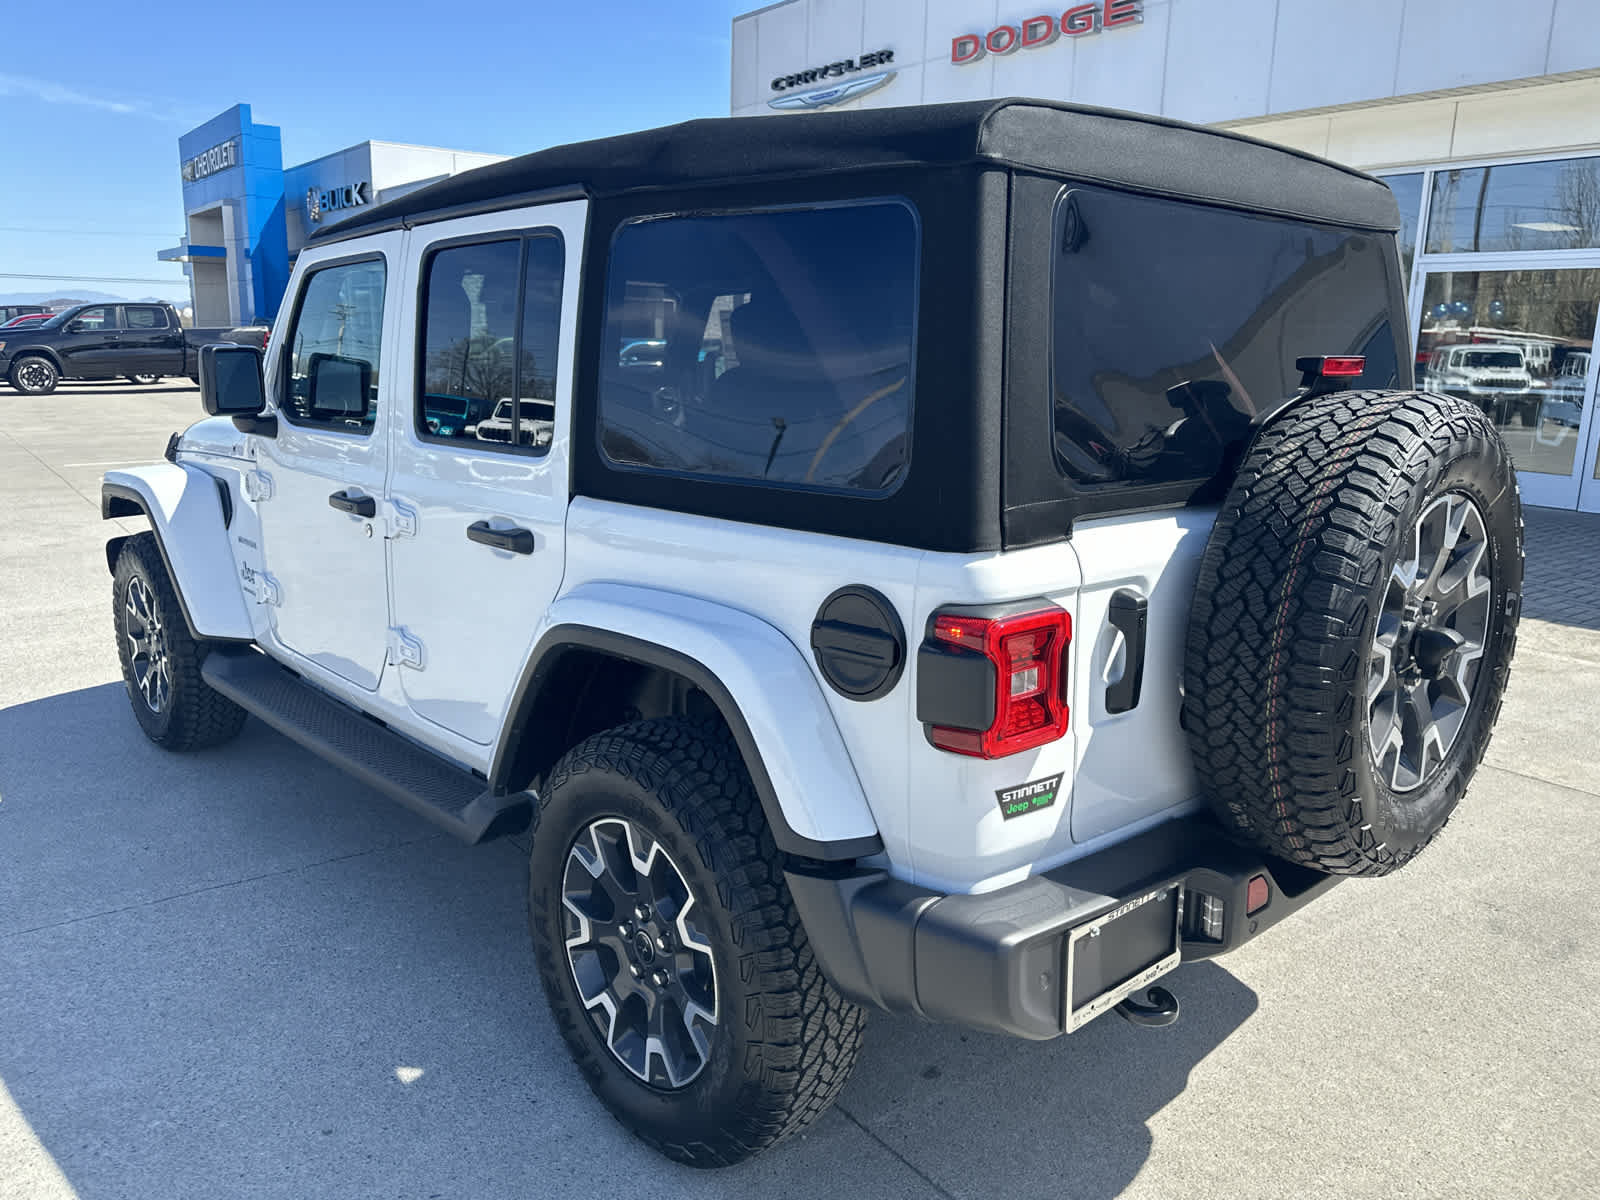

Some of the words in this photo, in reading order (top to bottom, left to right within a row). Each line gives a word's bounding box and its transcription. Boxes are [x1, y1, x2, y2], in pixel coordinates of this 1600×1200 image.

[951, 0, 1144, 65] DODGE
[771, 49, 895, 91] CHRYSLER
[194, 140, 236, 179] CHEVROLET
[320, 181, 368, 212] BUICK
[1002, 777, 1059, 803] STINNETT
[1006, 801, 1029, 815] Jeep
